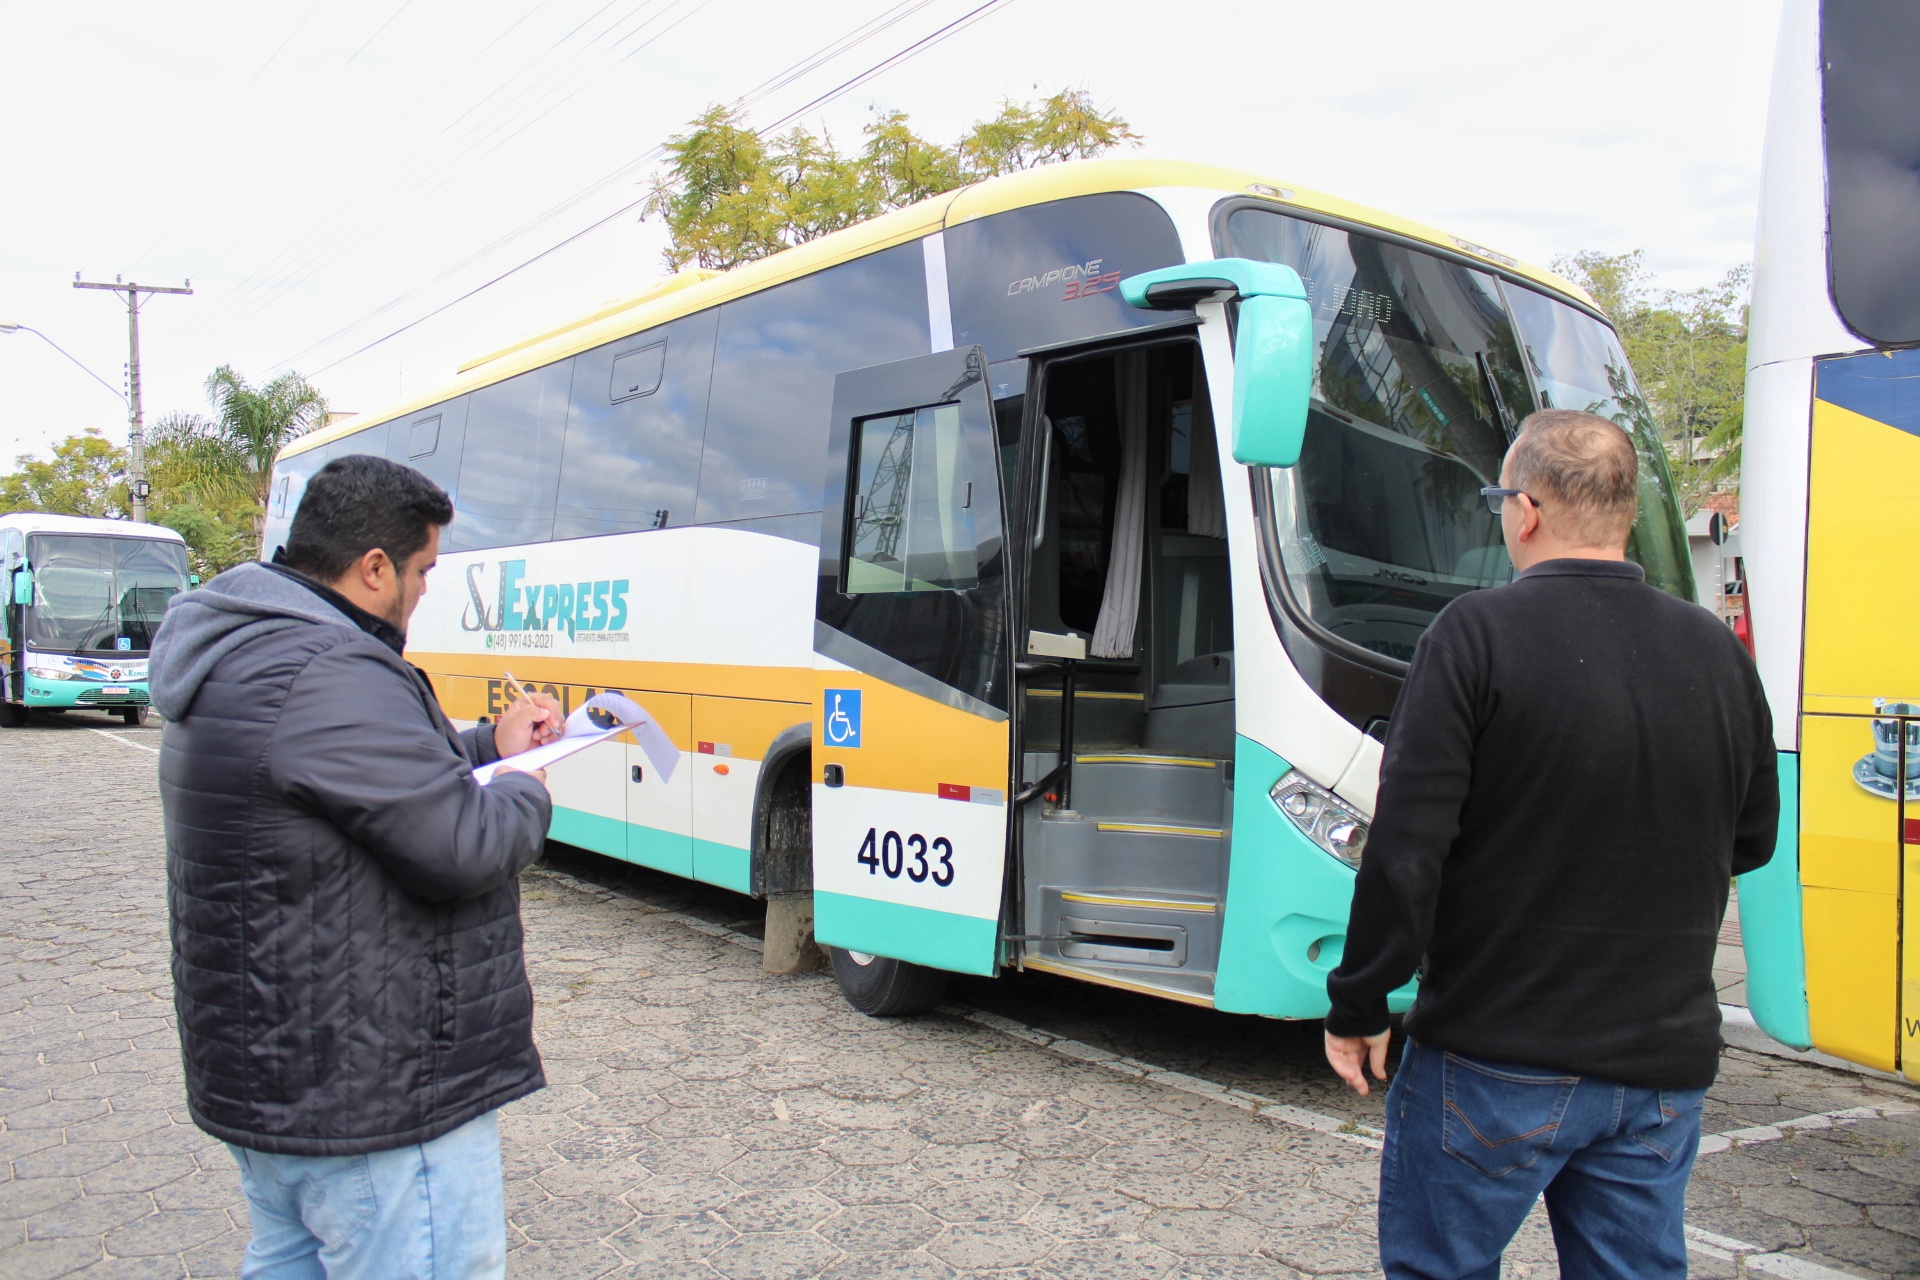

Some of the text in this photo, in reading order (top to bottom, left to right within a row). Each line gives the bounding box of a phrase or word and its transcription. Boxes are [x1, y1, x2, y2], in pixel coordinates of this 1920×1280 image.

[1007, 258, 1103, 297] CAMPIONE
[1062, 270, 1122, 302] 3.25
[1321, 284, 1392, 323] JOAO
[492, 633, 554, 651] (48) 99143-2021
[857, 827, 955, 888] 4033
